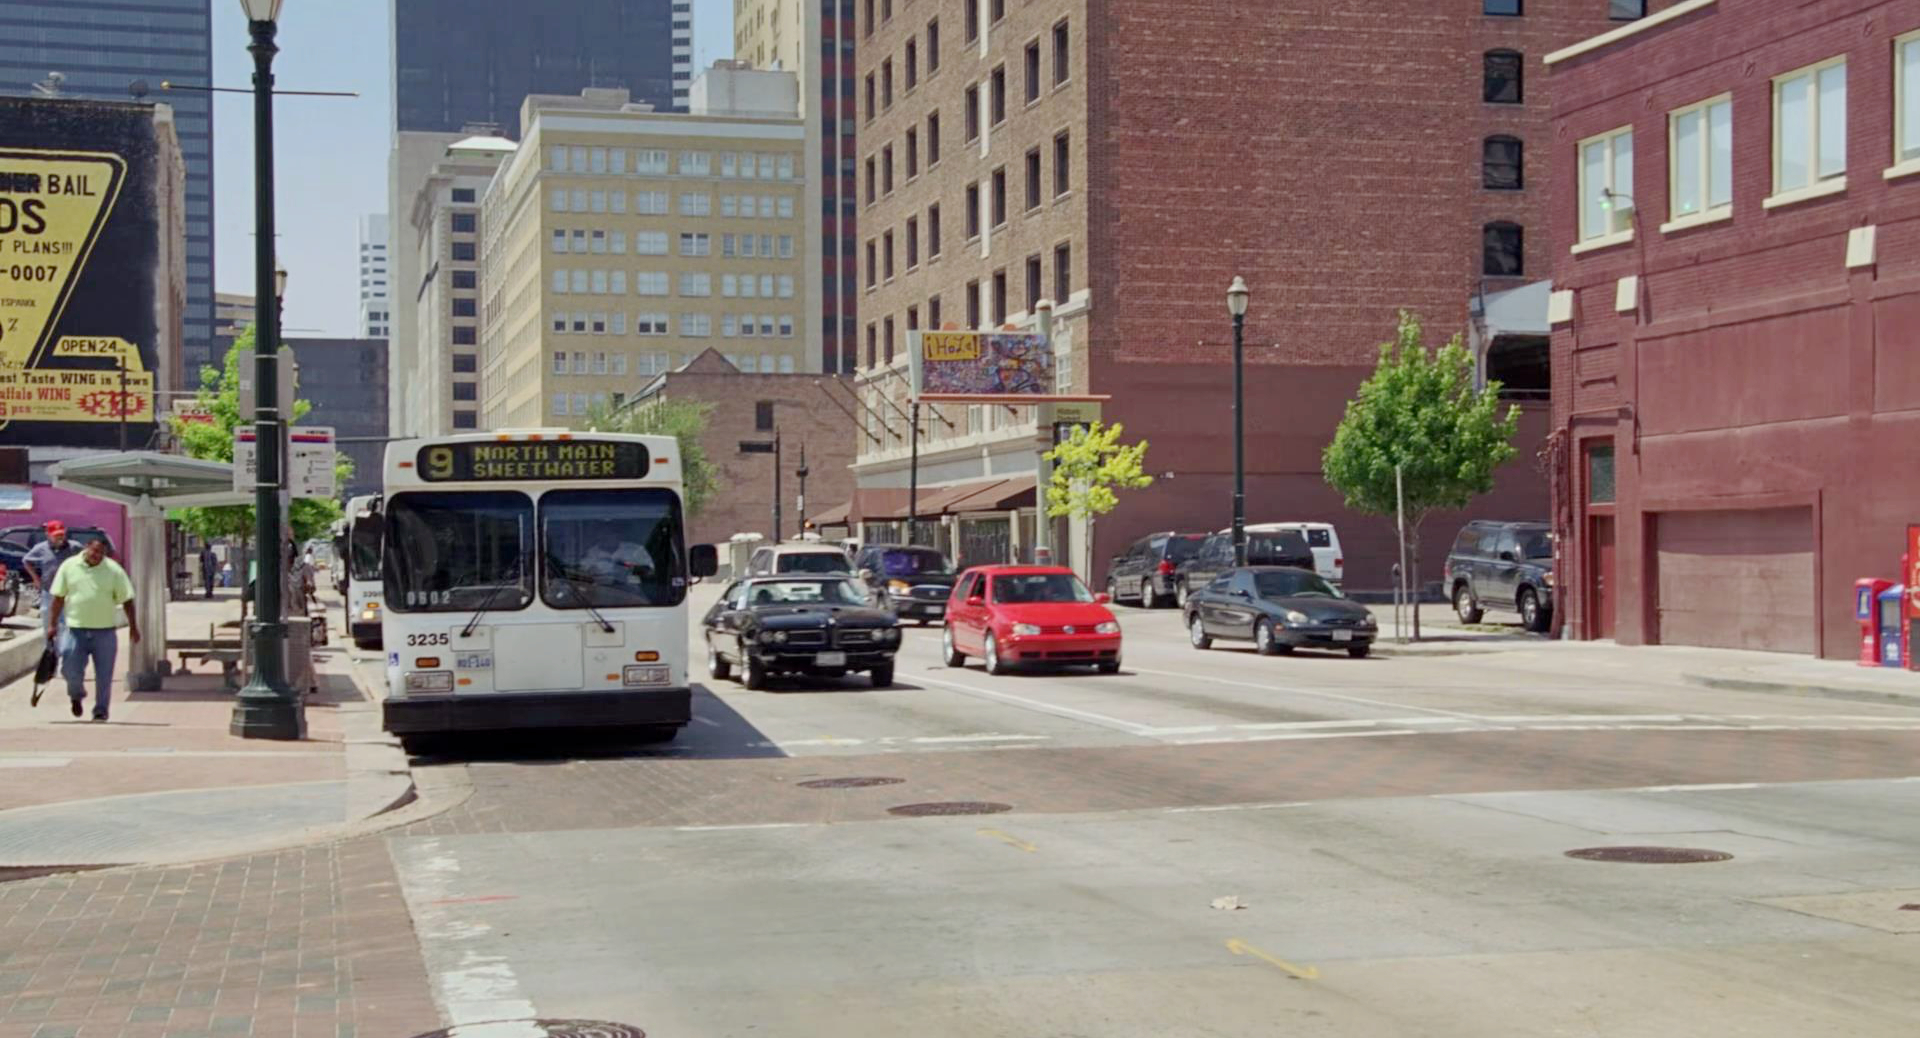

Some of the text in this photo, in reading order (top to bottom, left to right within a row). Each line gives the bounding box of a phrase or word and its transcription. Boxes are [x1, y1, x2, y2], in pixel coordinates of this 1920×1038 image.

[47, 174, 96, 196] BAIL
[14, 241, 72, 254] PLANS!!!
[62, 340, 96, 352] OPEN
[99, 341, 116, 352] 24
[22, 372, 55, 384] Taste
[61, 373, 96, 384] WING
[101, 375, 111, 385] in
[37, 388, 71, 400] WING
[474, 444, 615, 461] NORTH MAIN
[428, 448, 453, 478] 9
[473, 461, 615, 477] SWEETWATER
[407, 633, 449, 646] 3235
